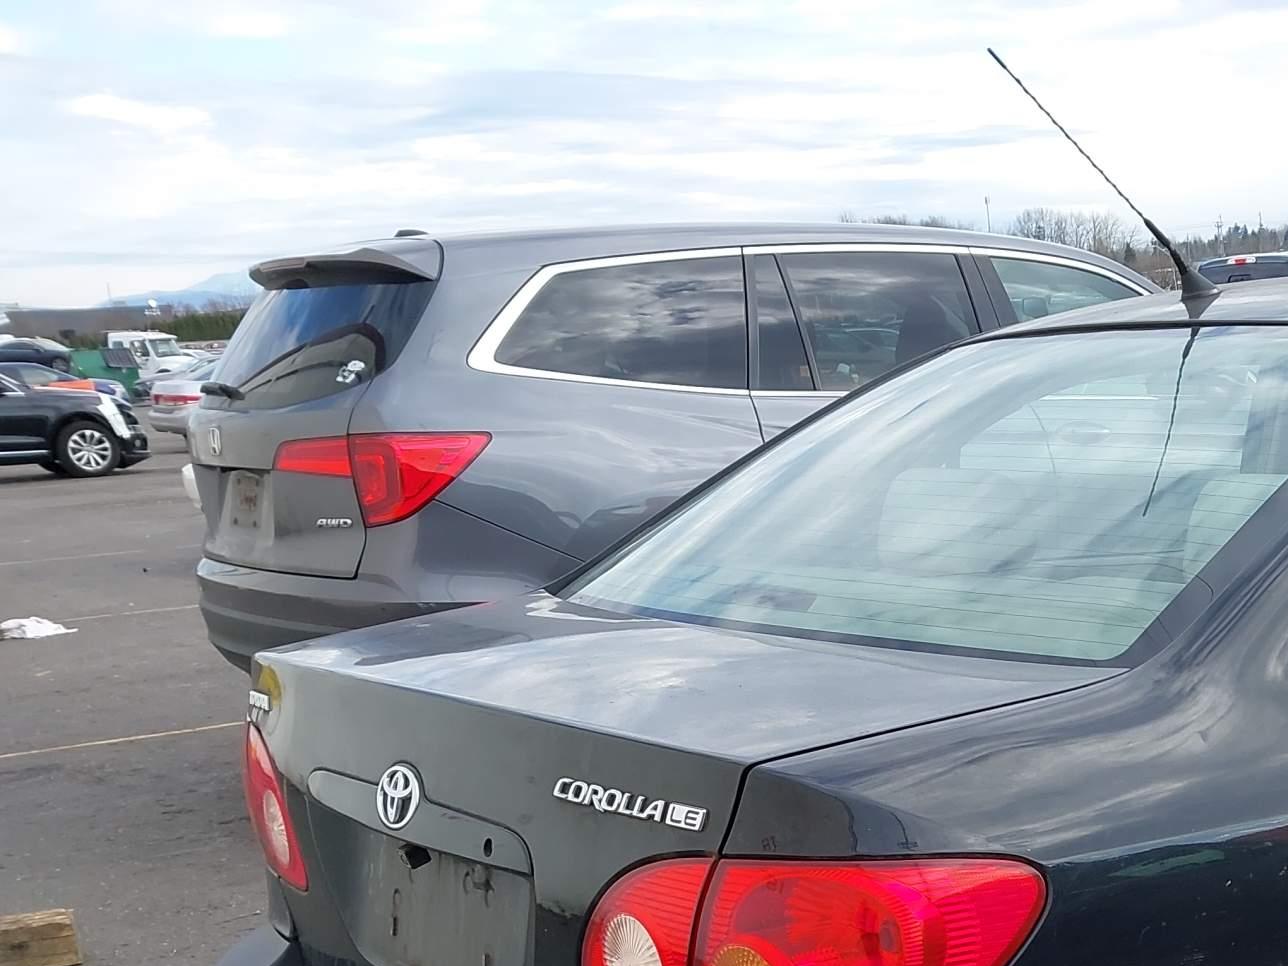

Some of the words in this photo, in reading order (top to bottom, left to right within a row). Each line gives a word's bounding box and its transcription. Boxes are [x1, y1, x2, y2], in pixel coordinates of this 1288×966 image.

[316, 518, 353, 528] AWD
[552, 777, 665, 823] COROLLA
[667, 803, 706, 831] LE
